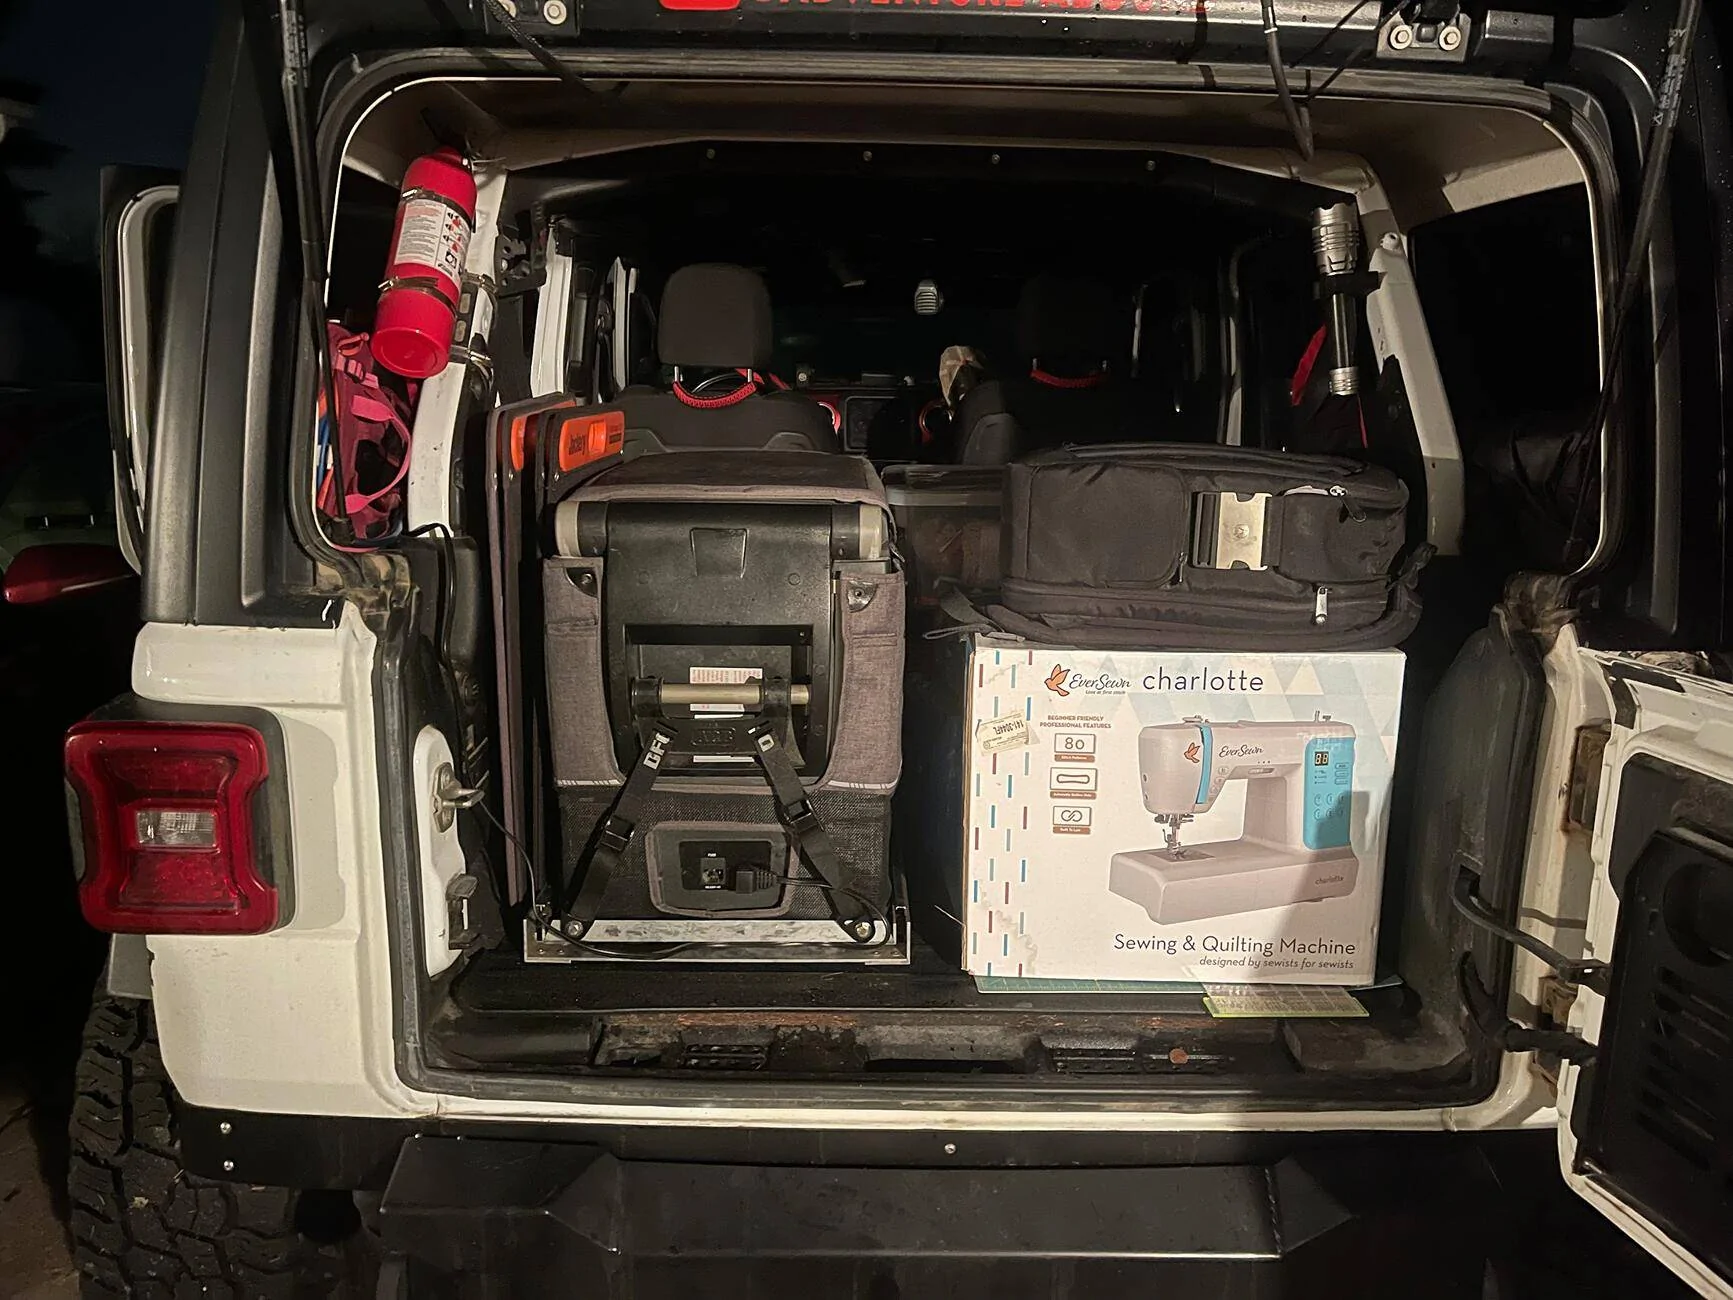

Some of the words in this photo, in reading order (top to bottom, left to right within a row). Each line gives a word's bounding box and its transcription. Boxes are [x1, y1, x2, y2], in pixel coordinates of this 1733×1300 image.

[1068, 673, 1132, 690] EverSewn
[1142, 666, 1264, 691] charlotte
[1039, 721, 1082, 729] PROFESSIONAL
[1064, 737, 1085, 750] 80
[1218, 744, 1264, 758] EverSewn
[1113, 933, 1178, 955] Sewing
[1182, 936, 1196, 952] &
[1202, 935, 1275, 957] Quilting
[1279, 938, 1356, 955] Machine
[1199, 956, 1245, 969] designed
[1247, 957, 1261, 969] by
[1263, 958, 1298, 968] sewists
[1300, 957, 1316, 969] for
[1318, 958, 1354, 969] sewists
